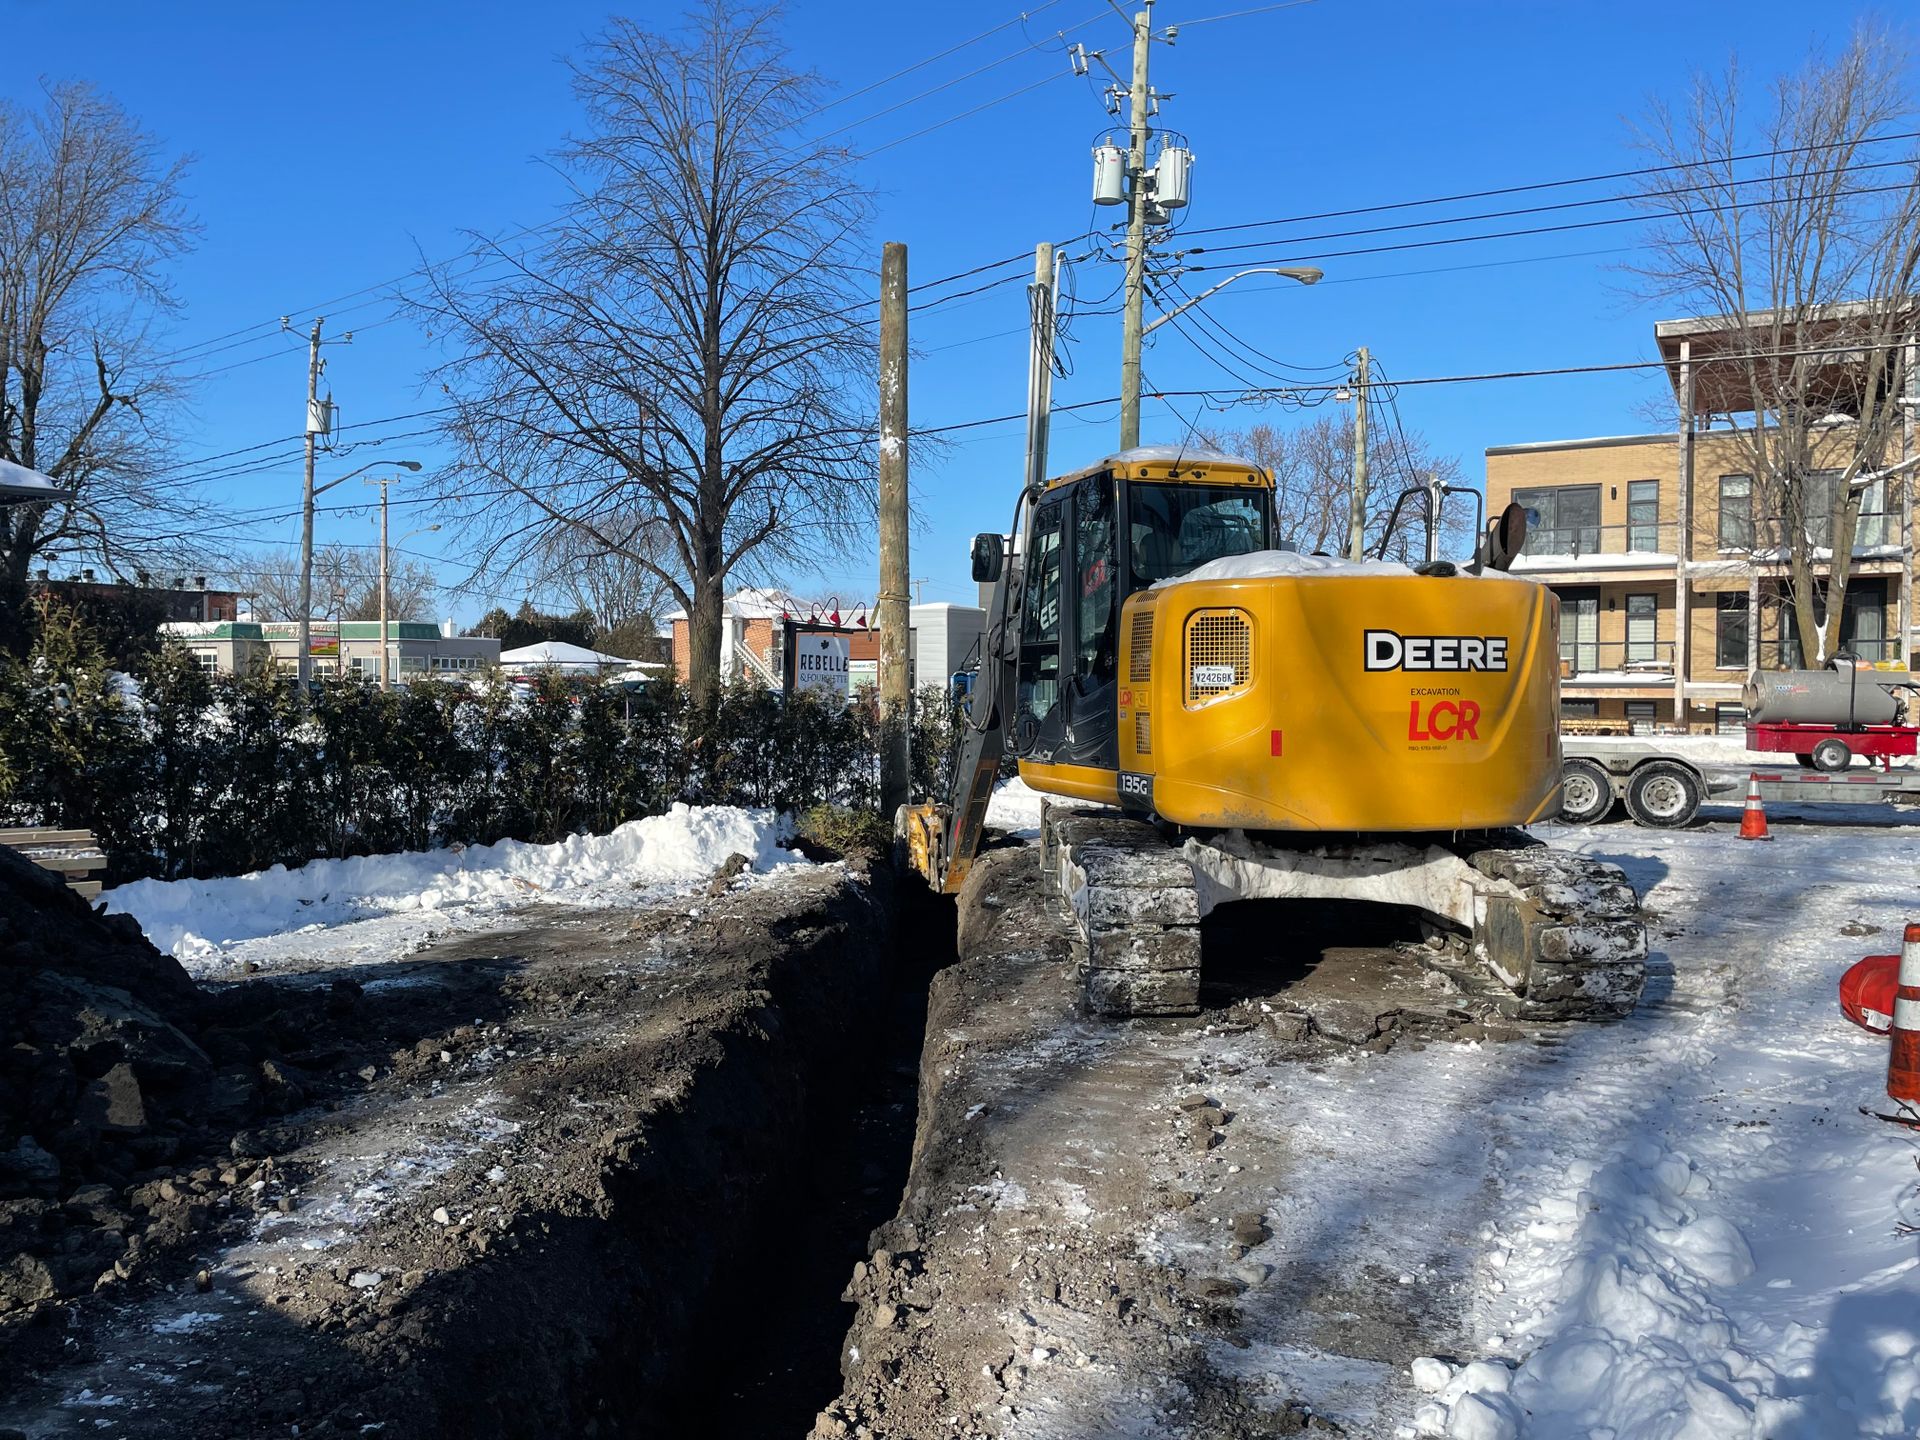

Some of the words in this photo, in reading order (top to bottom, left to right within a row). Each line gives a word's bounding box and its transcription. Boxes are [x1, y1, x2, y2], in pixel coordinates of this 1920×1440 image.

[1365, 630, 1508, 671] DEERE
[800, 654, 848, 672] REBELLE
[1410, 688, 1460, 696] EXCAVATION
[1408, 700, 1481, 741] LCR
[1121, 774, 1148, 795] 135G
